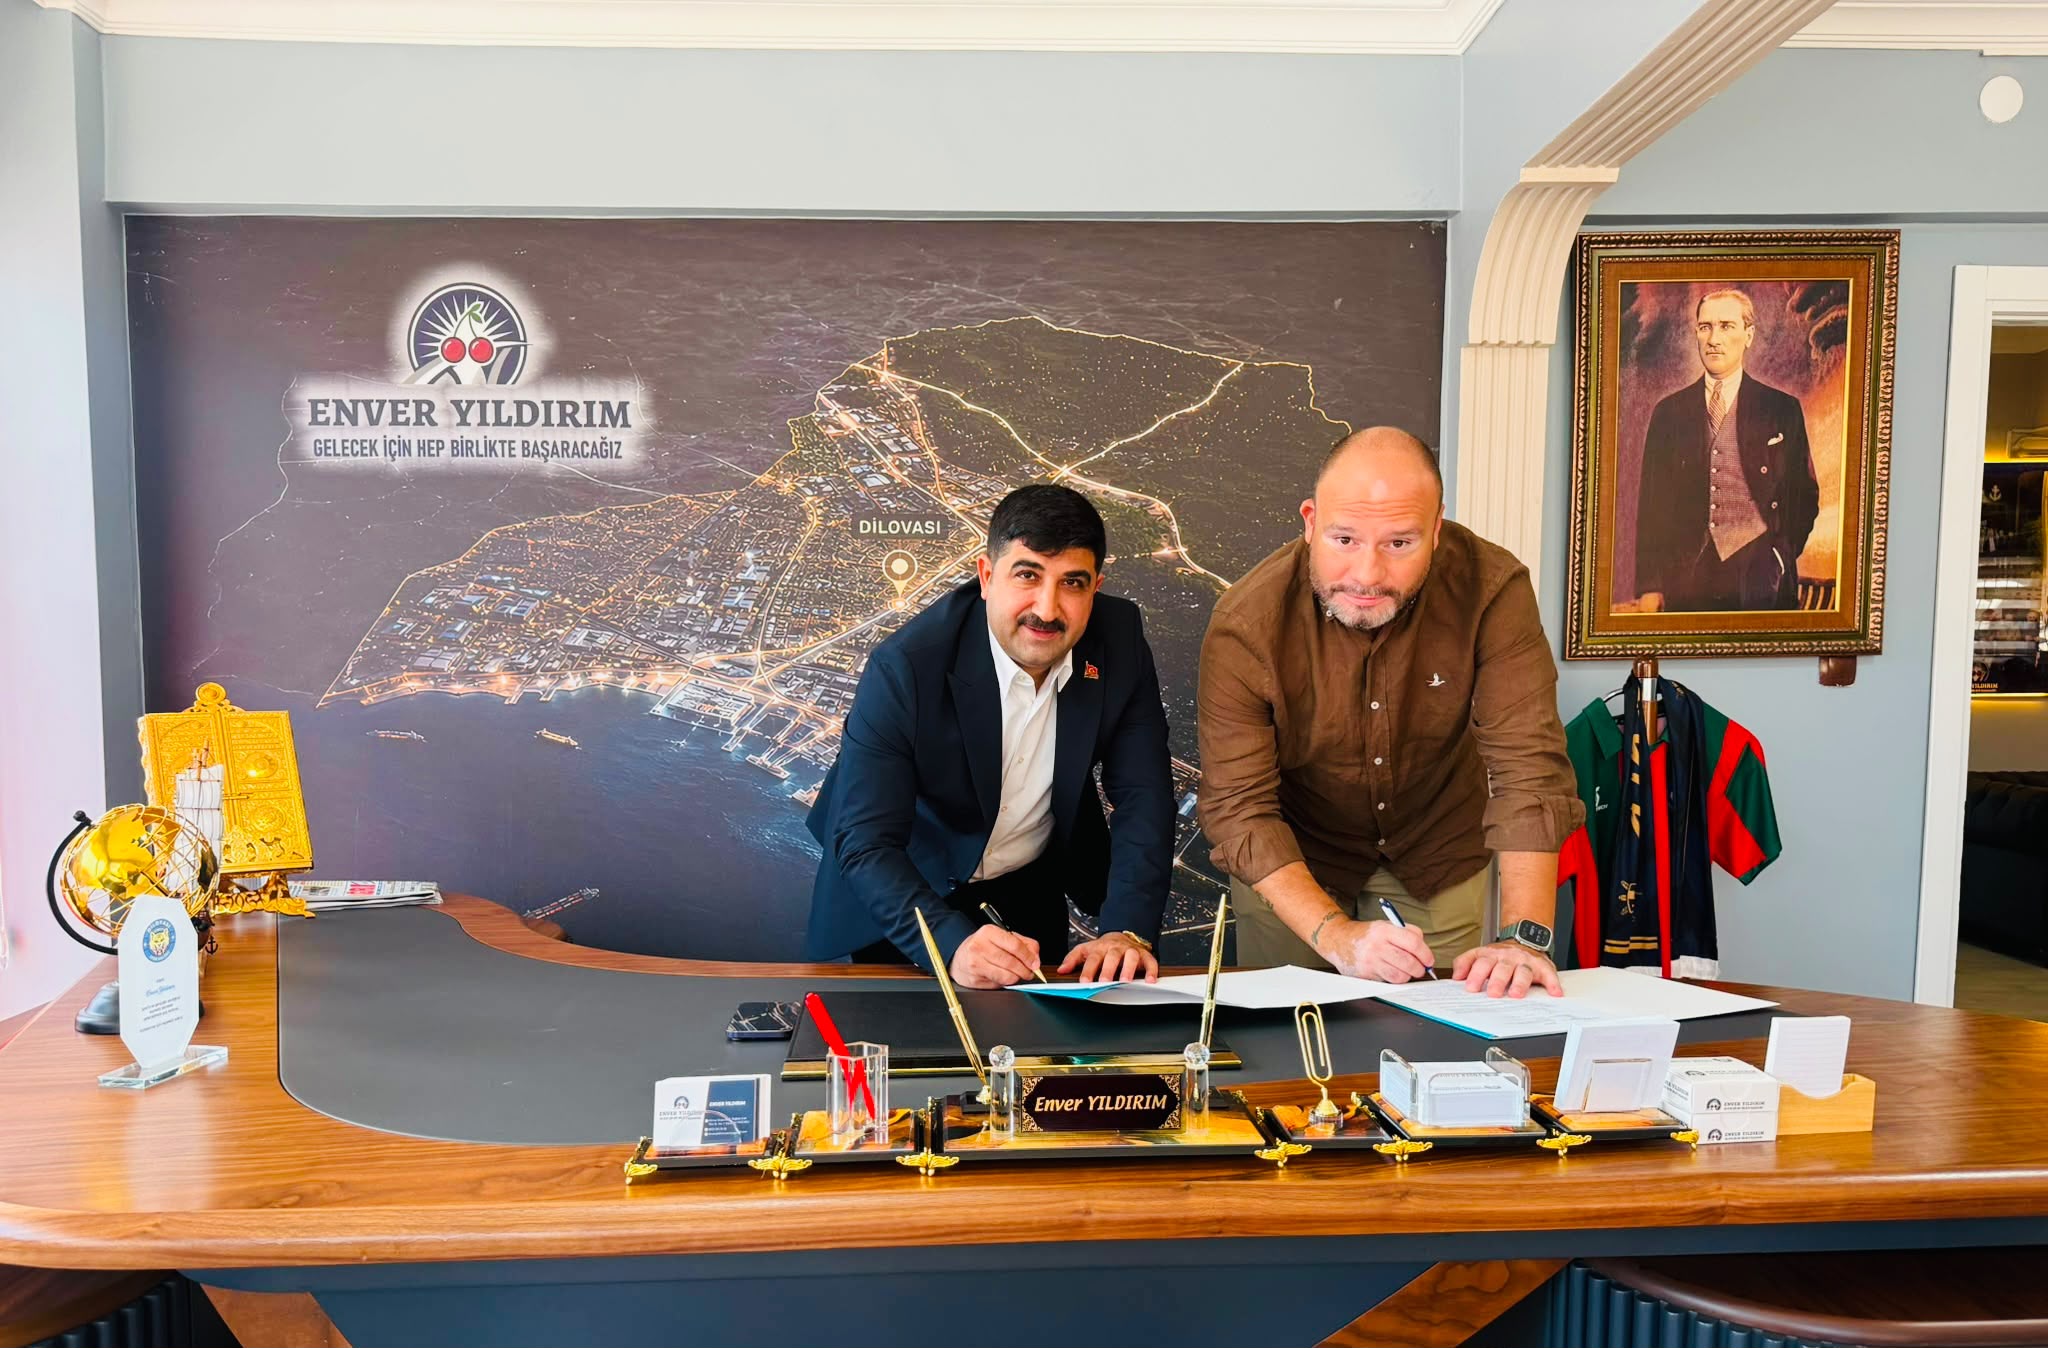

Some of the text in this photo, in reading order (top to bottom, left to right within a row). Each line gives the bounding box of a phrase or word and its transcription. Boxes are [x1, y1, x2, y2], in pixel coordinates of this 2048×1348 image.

[308, 398, 632, 429] ENVER YILDIRIM
[313, 434, 623, 464] GELECEK İÇİN HEP BİRLİKTE BAŞARACAĞIZ
[859, 516, 941, 535] DİLOVASI
[1034, 1094, 1168, 1112] Enver YILDIRIM
